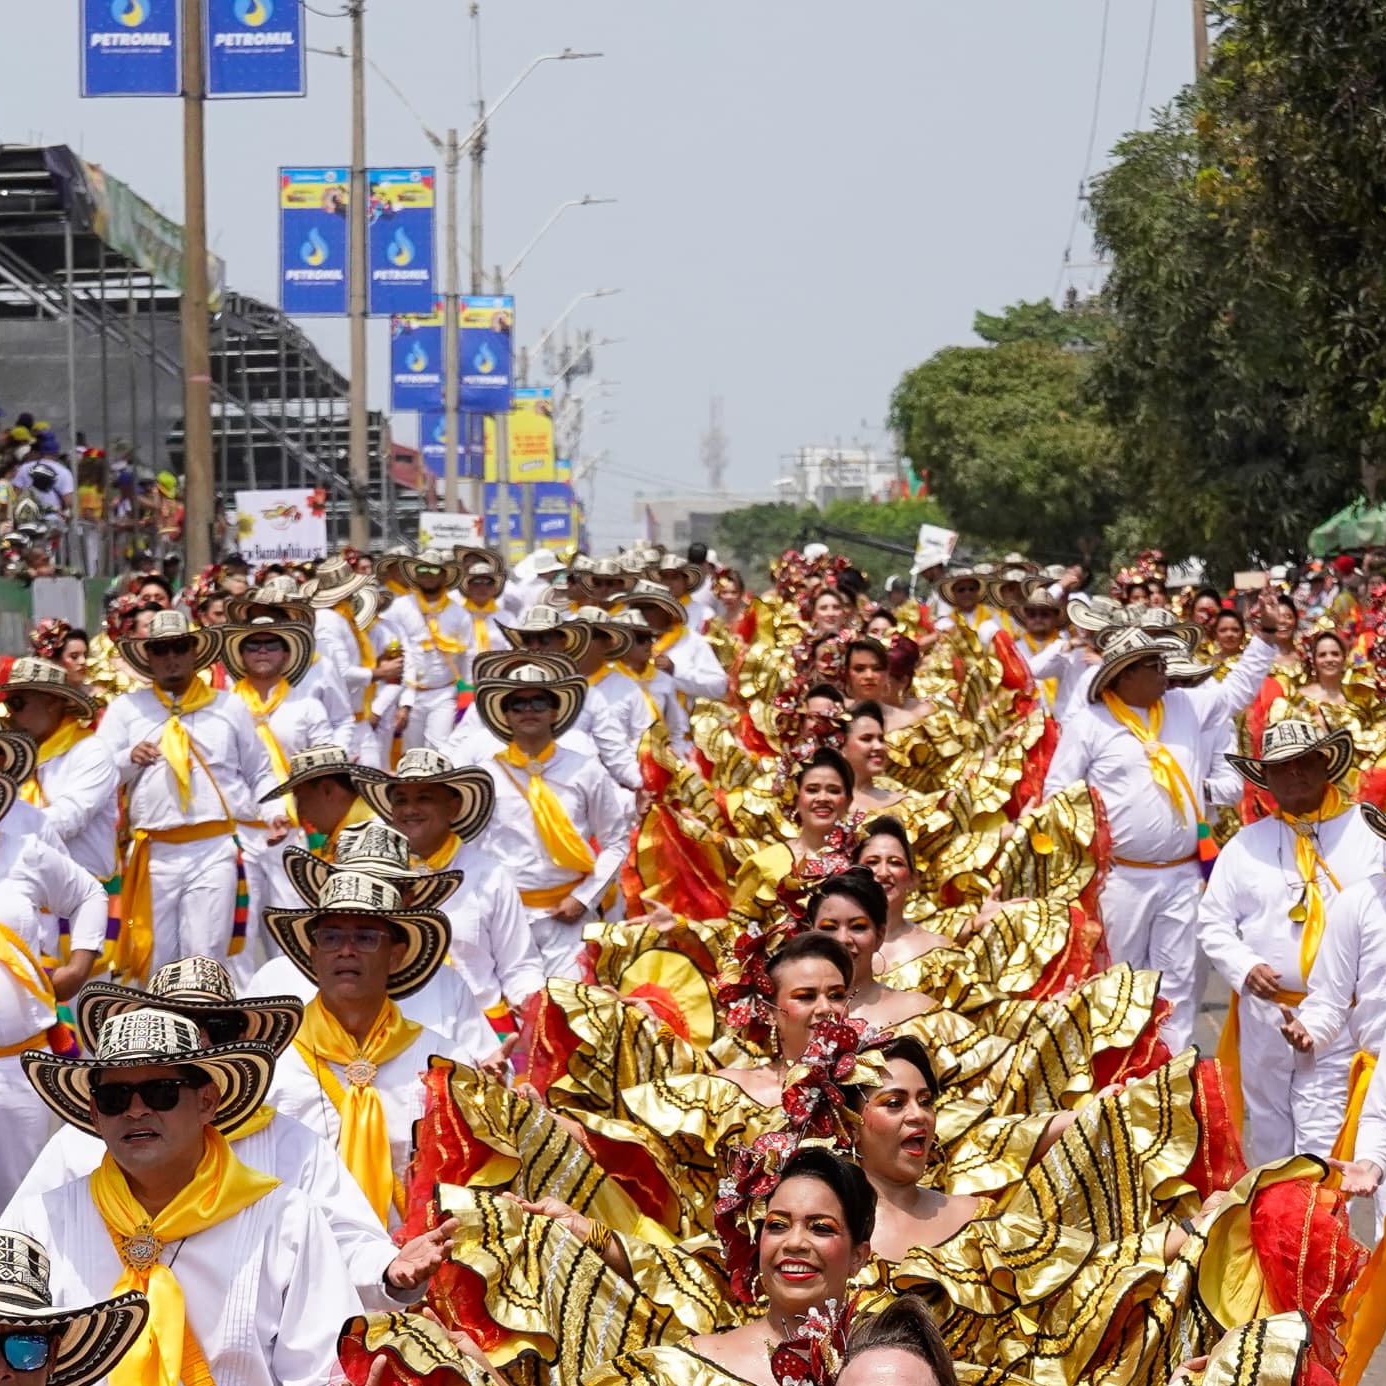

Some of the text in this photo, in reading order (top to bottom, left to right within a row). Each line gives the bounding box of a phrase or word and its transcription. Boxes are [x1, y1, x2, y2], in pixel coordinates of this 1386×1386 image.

[91, 32, 172, 47] PETROMIL
[215, 31, 295, 47] PETROMIL
[285, 269, 344, 281] PETROMIL
[372, 269, 429, 281] PETROMIL
